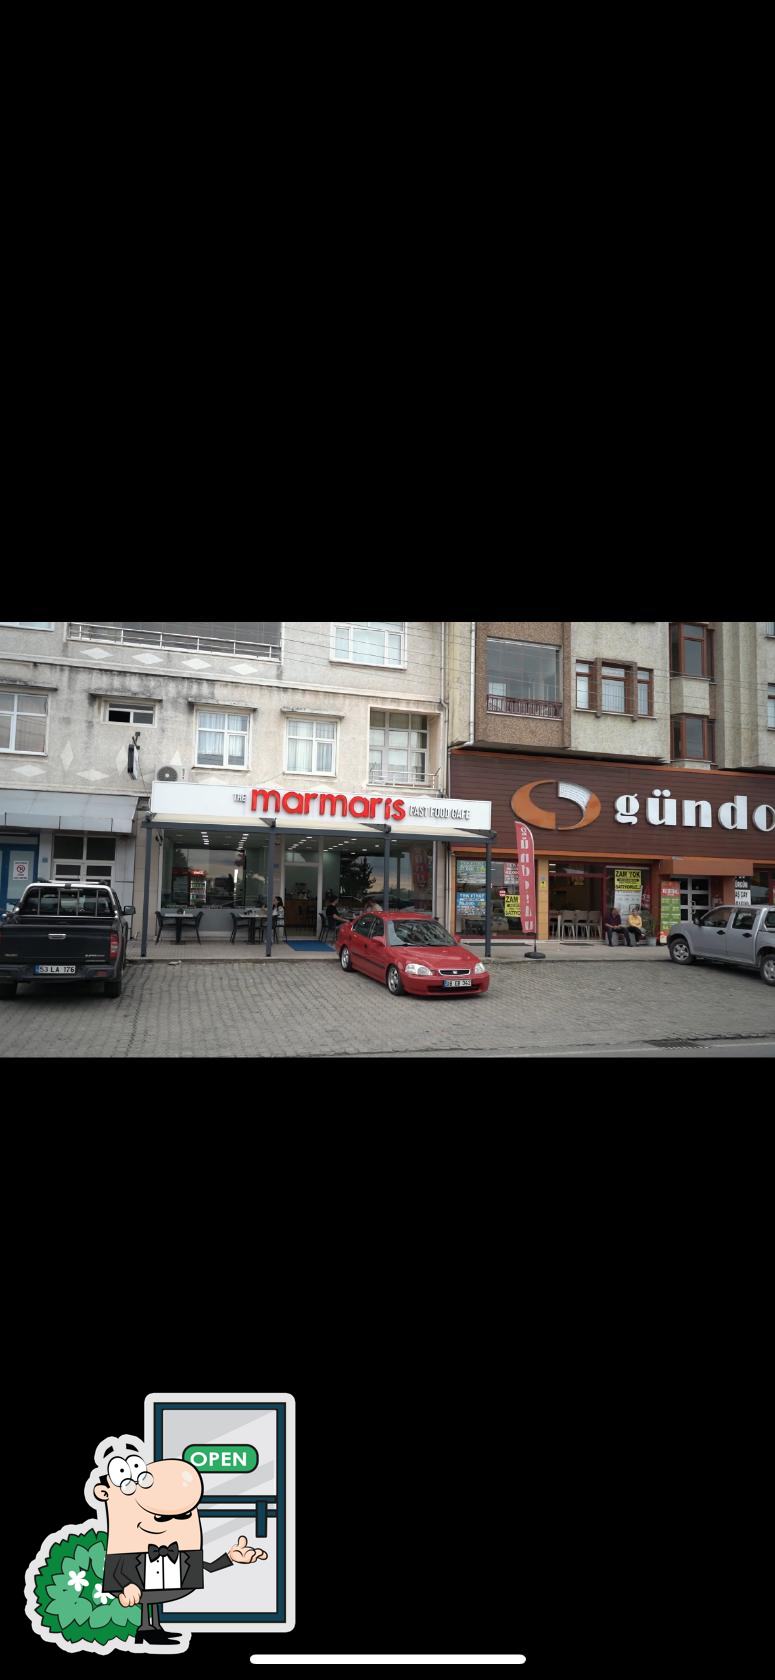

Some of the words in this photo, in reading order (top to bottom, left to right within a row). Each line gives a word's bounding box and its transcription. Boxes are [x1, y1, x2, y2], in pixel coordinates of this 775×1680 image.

[232, 793, 246, 803] THE
[251, 788, 406, 821] marmaris
[409, 805, 427, 818] FAST
[430, 807, 449, 819] FOOD
[450, 809, 471, 820] CAFE
[614, 789, 775, 832] gündo
[505, 895, 519, 903] ZAM
